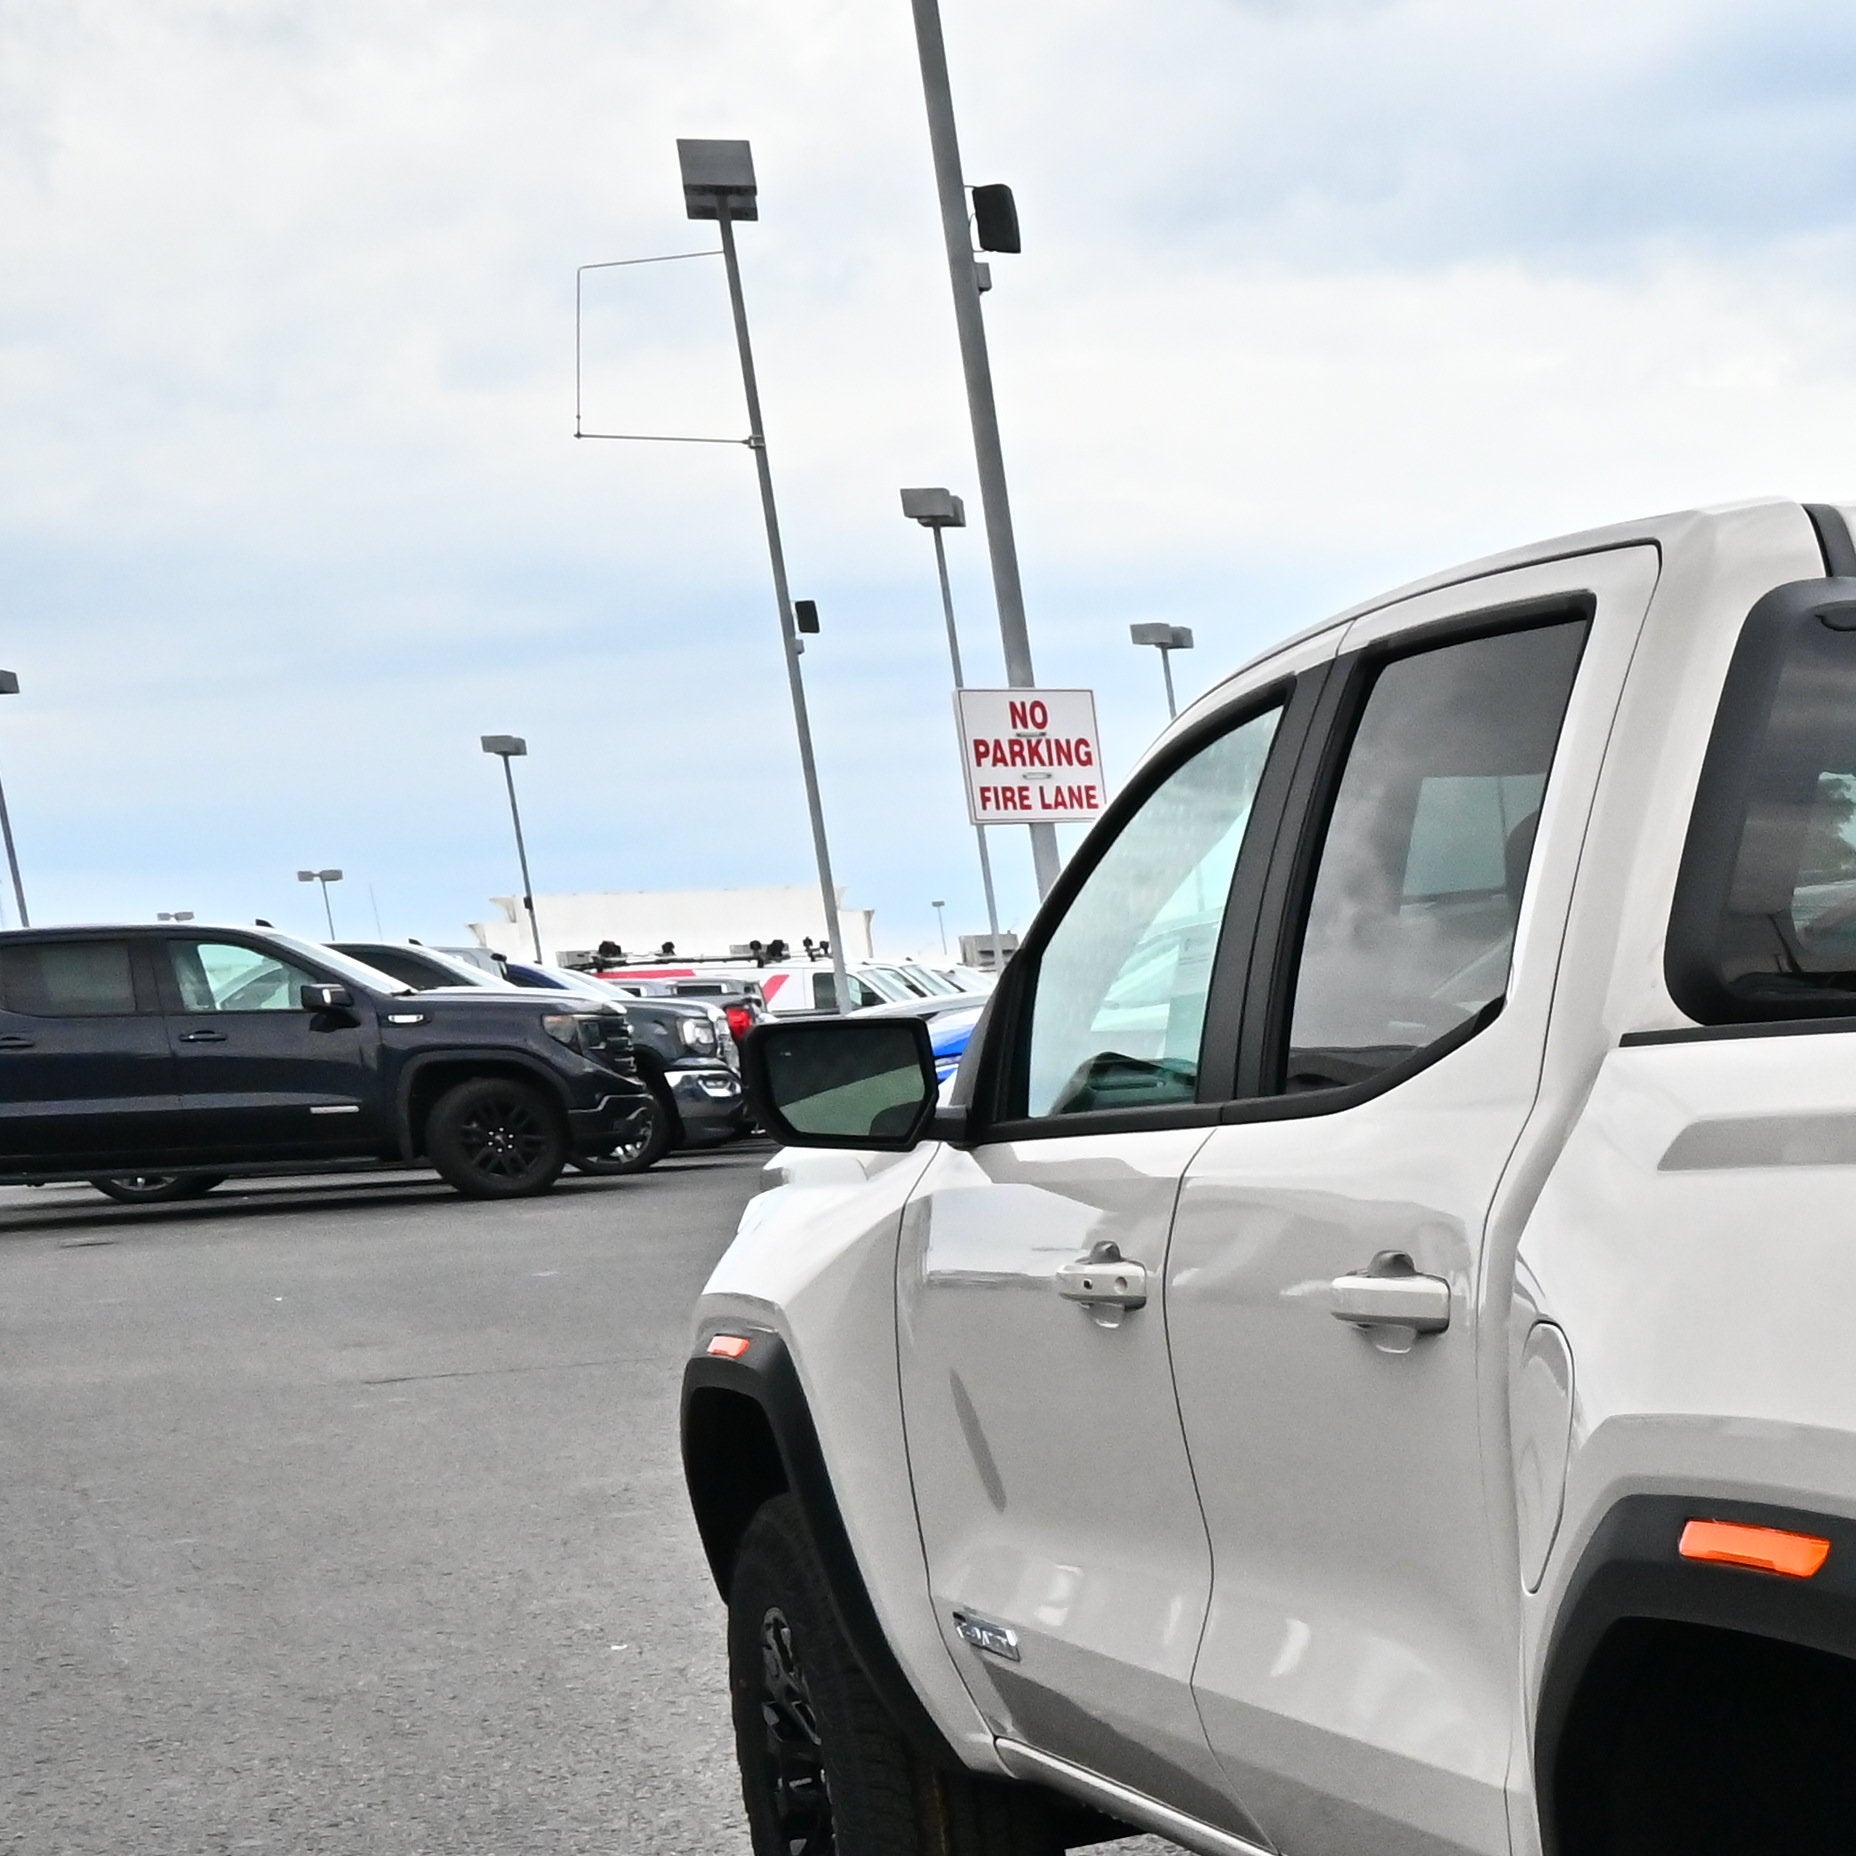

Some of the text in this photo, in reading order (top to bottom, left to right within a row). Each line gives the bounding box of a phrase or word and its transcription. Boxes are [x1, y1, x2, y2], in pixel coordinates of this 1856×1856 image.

[1009, 700, 1048, 729] NO
[973, 738, 1093, 767] PARKING
[979, 785, 1099, 810] FIRE LANE
